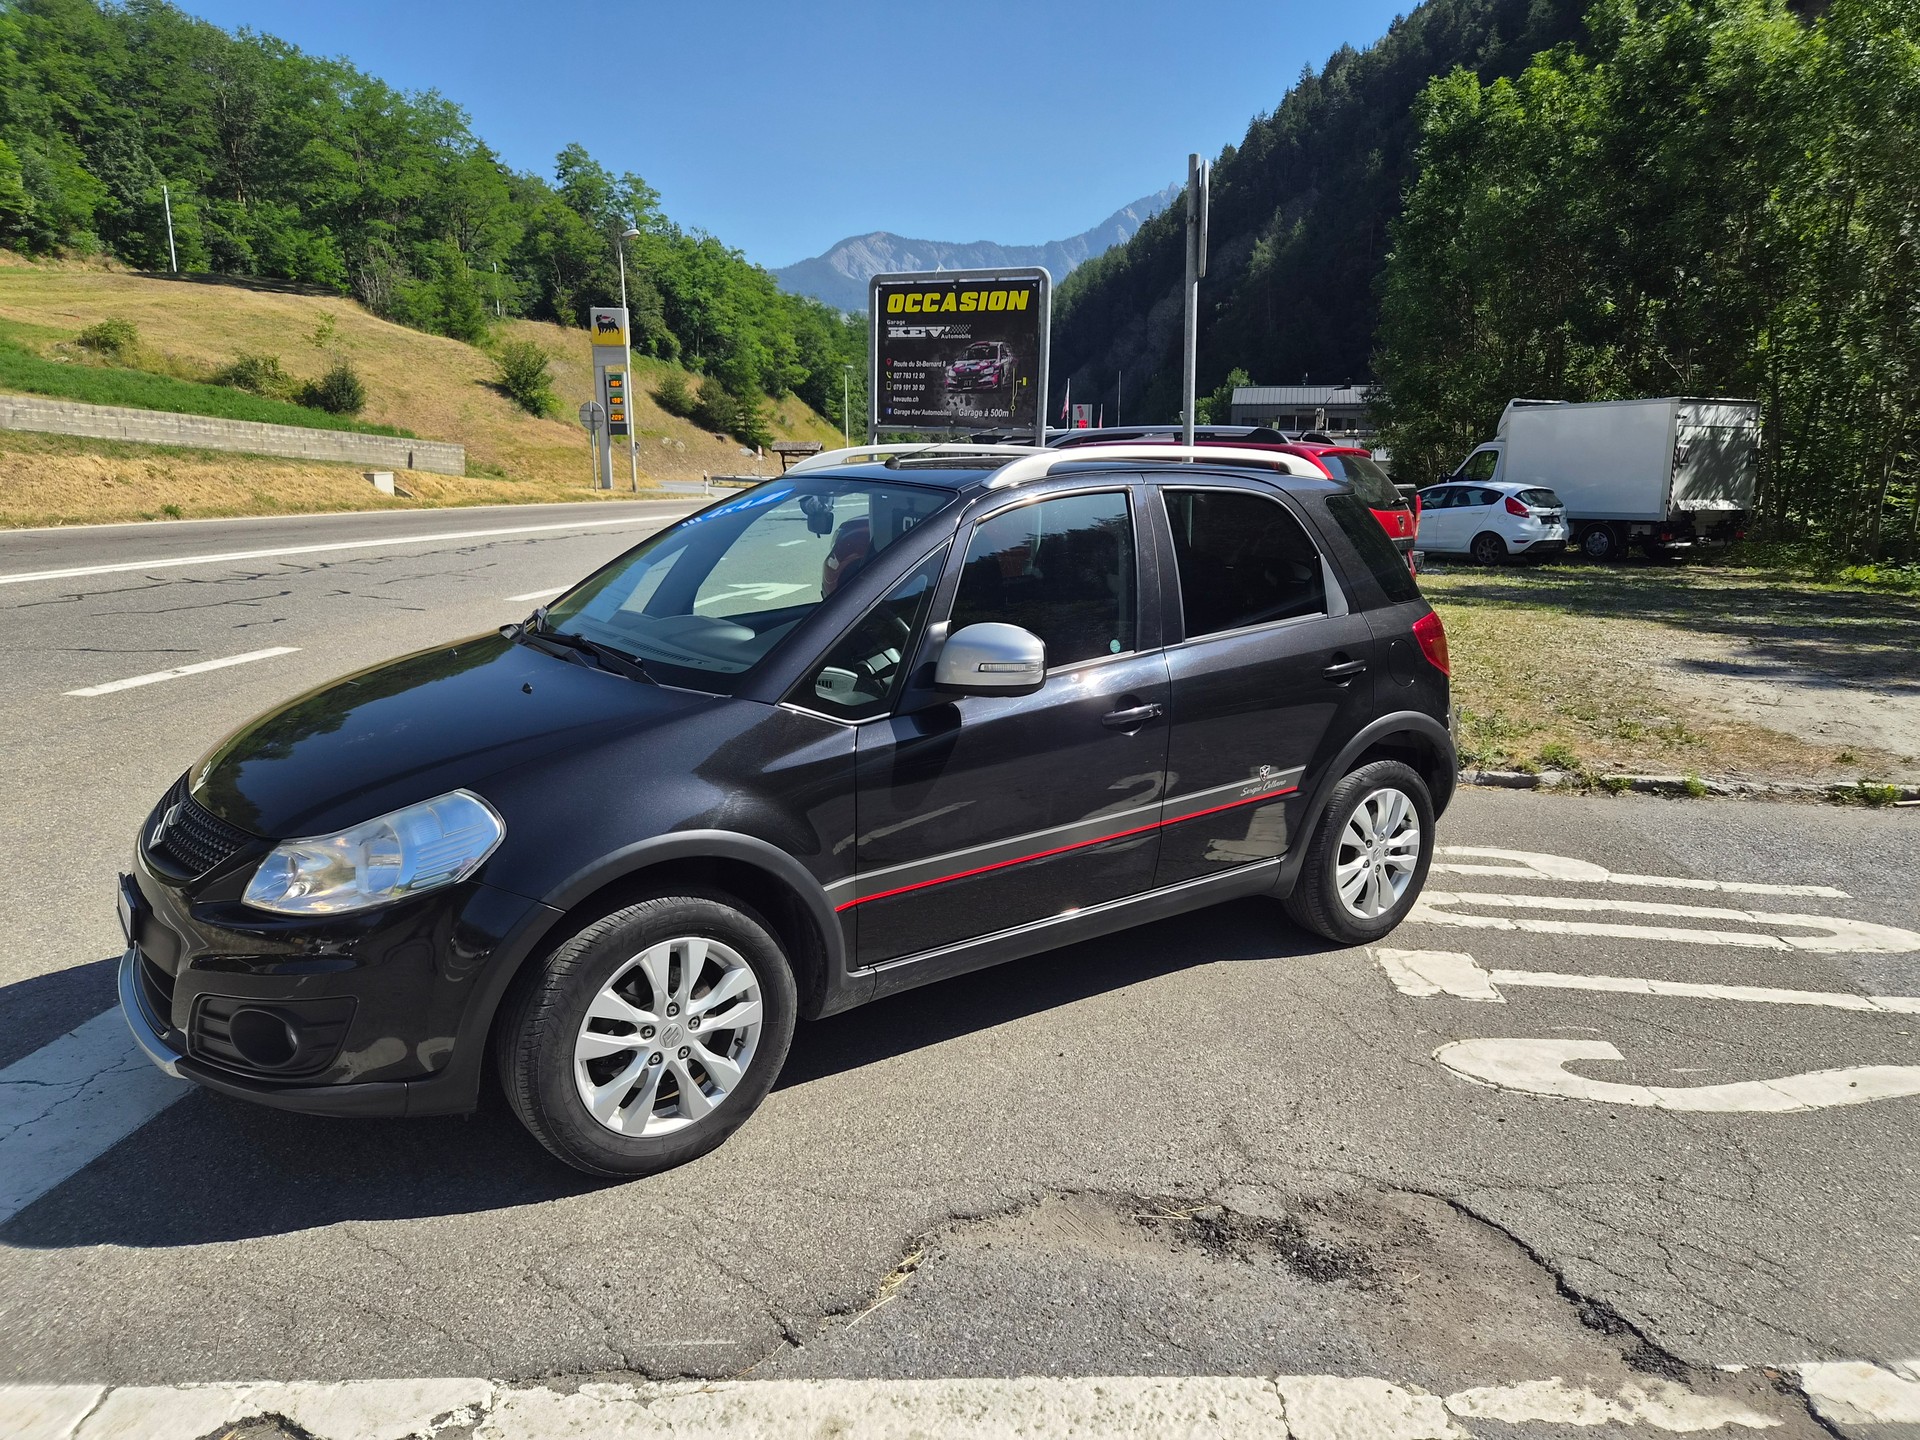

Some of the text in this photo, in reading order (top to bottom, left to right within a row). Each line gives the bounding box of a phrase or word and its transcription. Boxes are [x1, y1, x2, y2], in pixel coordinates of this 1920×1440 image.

[886, 290, 1030, 313] OCCASION
[893, 360, 908, 368] Route
[908, 360, 915, 368] du
[916, 360, 942, 368] St-Bernard
[893, 408, 911, 417] Garage
[958, 407, 983, 419] Garage
[990, 408, 1009, 417] 500m
